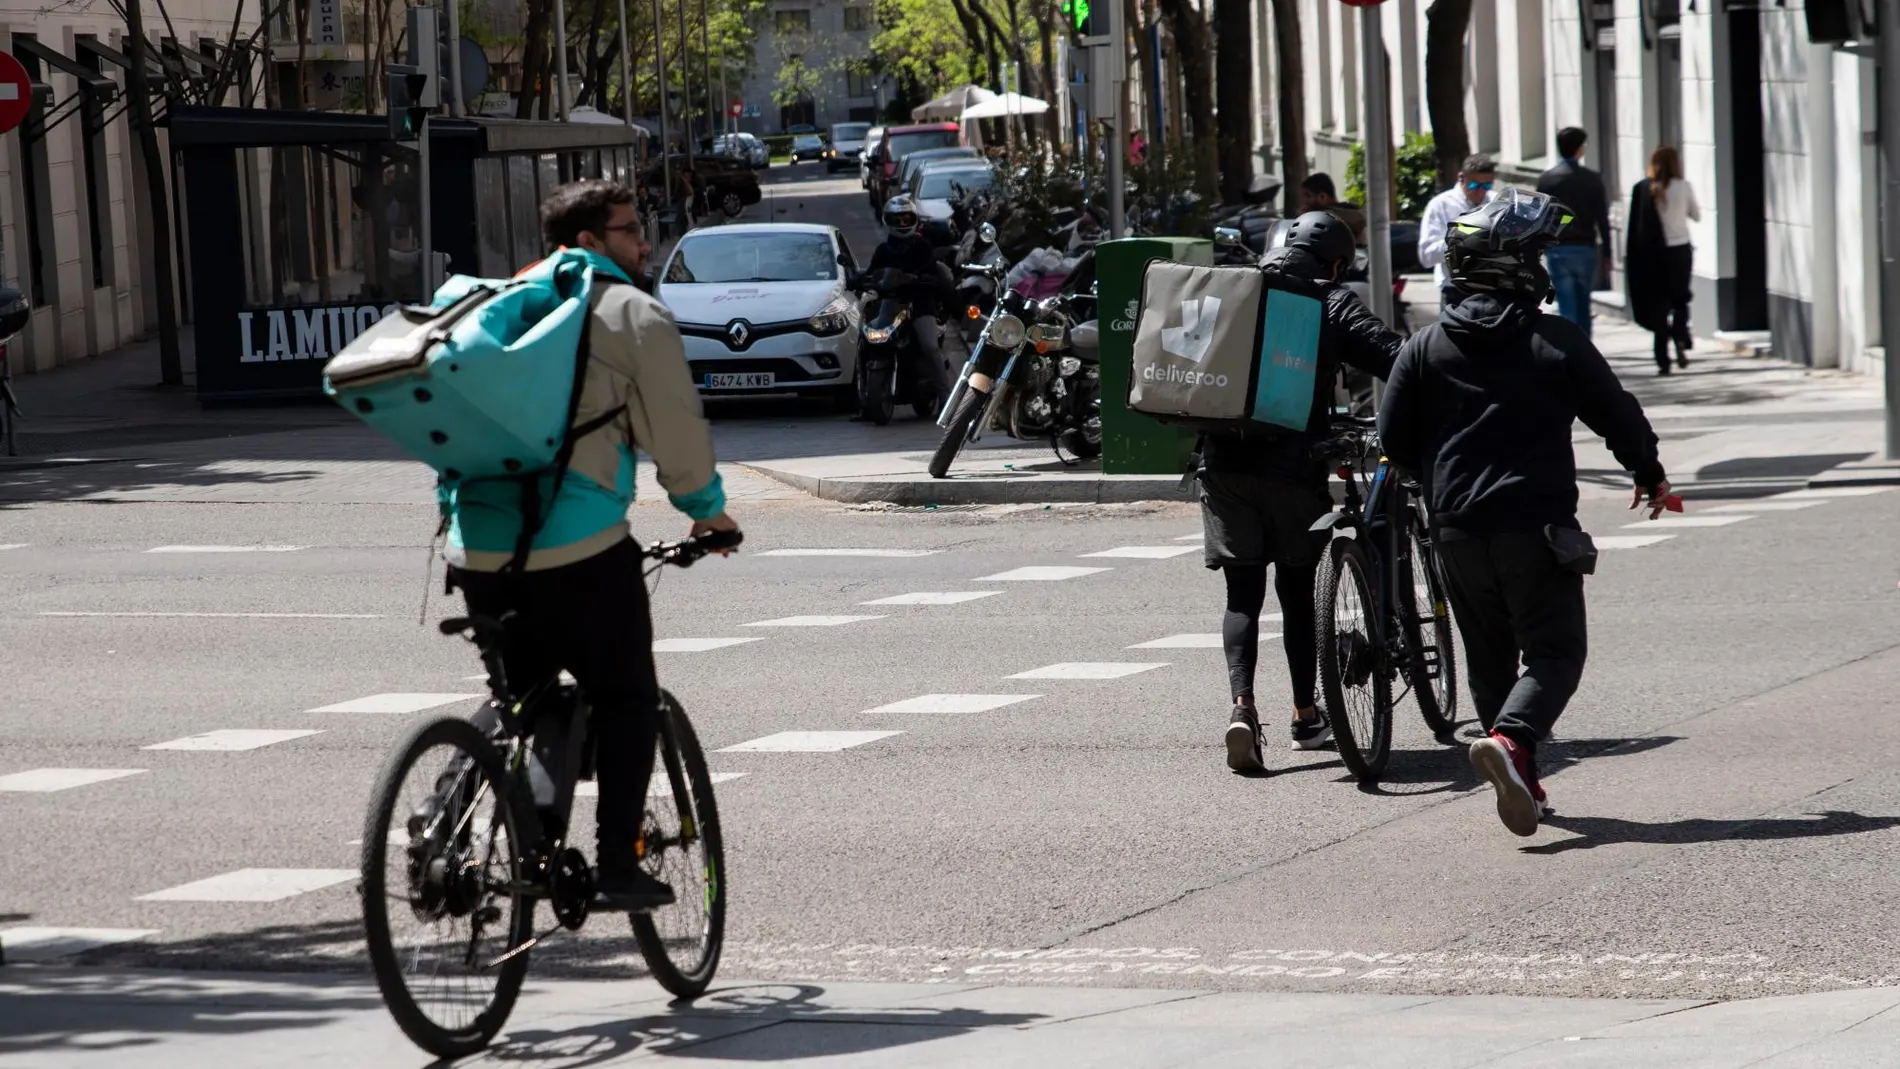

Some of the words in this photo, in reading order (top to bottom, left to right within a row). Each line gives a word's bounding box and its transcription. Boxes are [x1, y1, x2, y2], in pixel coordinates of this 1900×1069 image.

[238, 305, 397, 363] LAMUC
[712, 374, 743, 387] 6474
[747, 374, 771, 386] KWB
[1143, 362, 1229, 389] deliveroo
